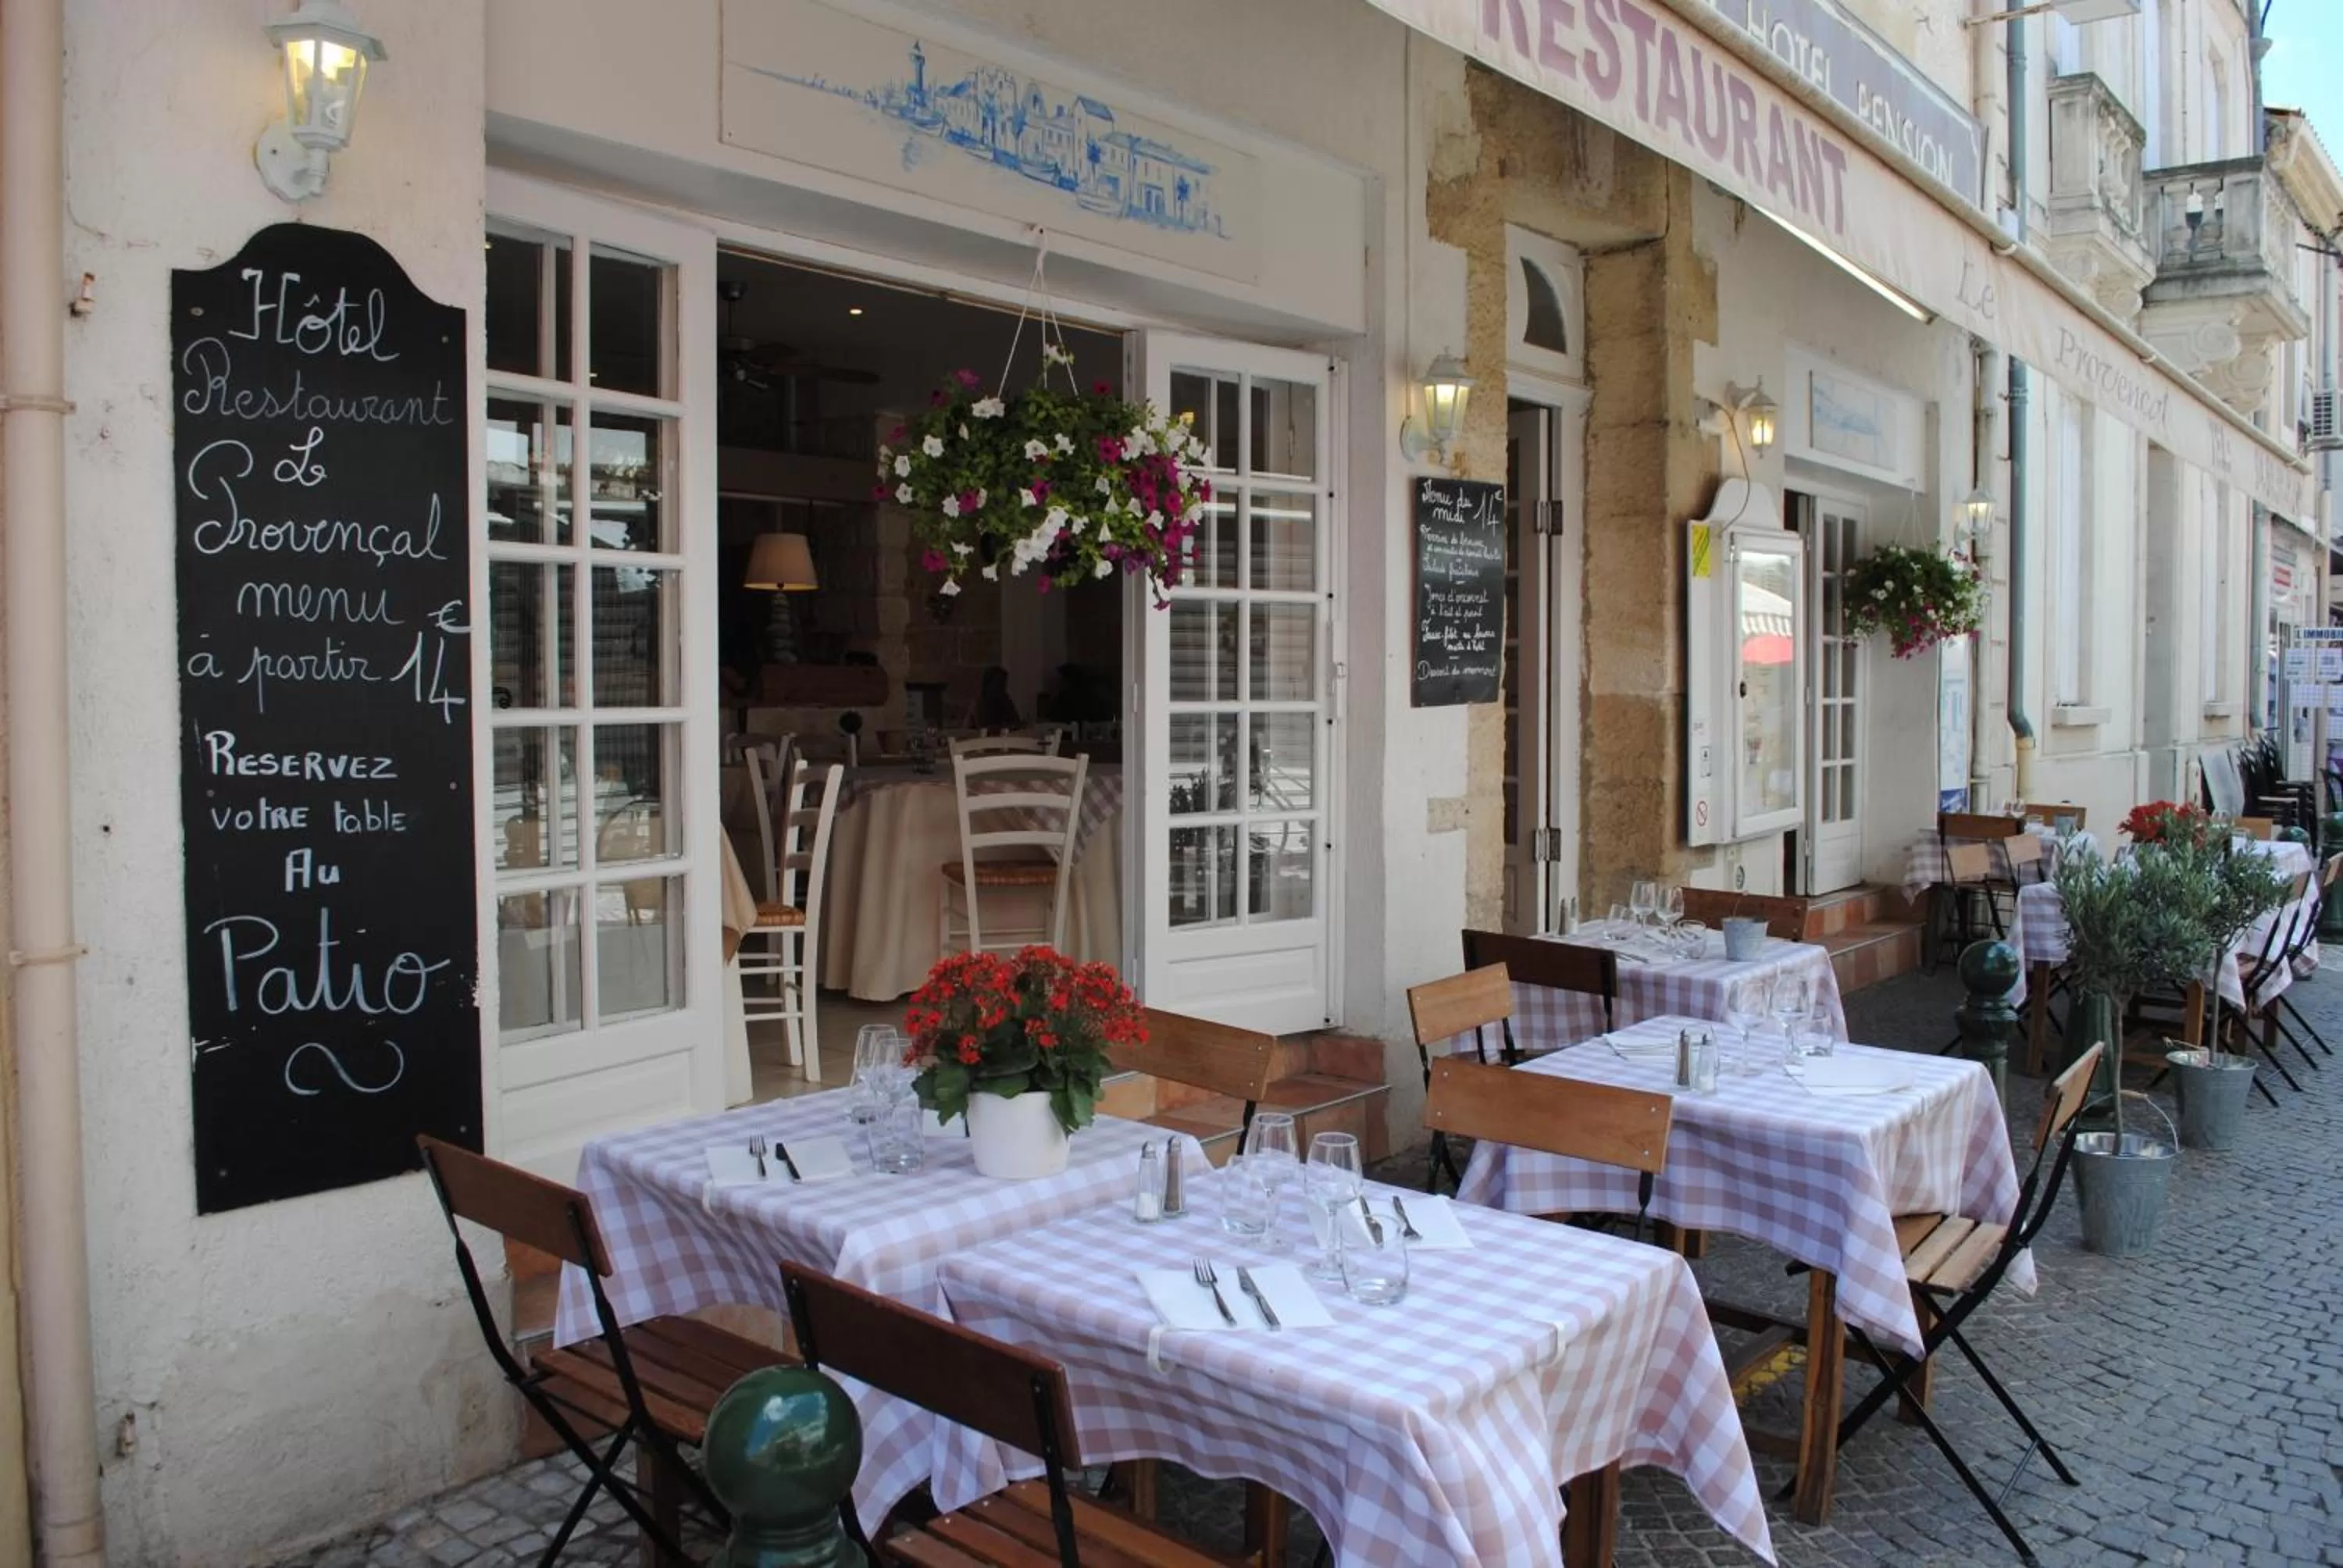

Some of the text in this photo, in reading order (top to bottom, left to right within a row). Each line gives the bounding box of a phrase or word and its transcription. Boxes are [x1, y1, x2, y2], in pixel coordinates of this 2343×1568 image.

[228, 269, 399, 362] Hôtel
[1956, 261, 1994, 319] Le
[184, 337, 453, 426] Restaurant
[274, 426, 326, 486] Le
[188, 440, 448, 568] Provençal
[237, 581, 405, 625] menu
[237, 636, 382, 714] partir
[203, 907, 451, 1015] Patio
